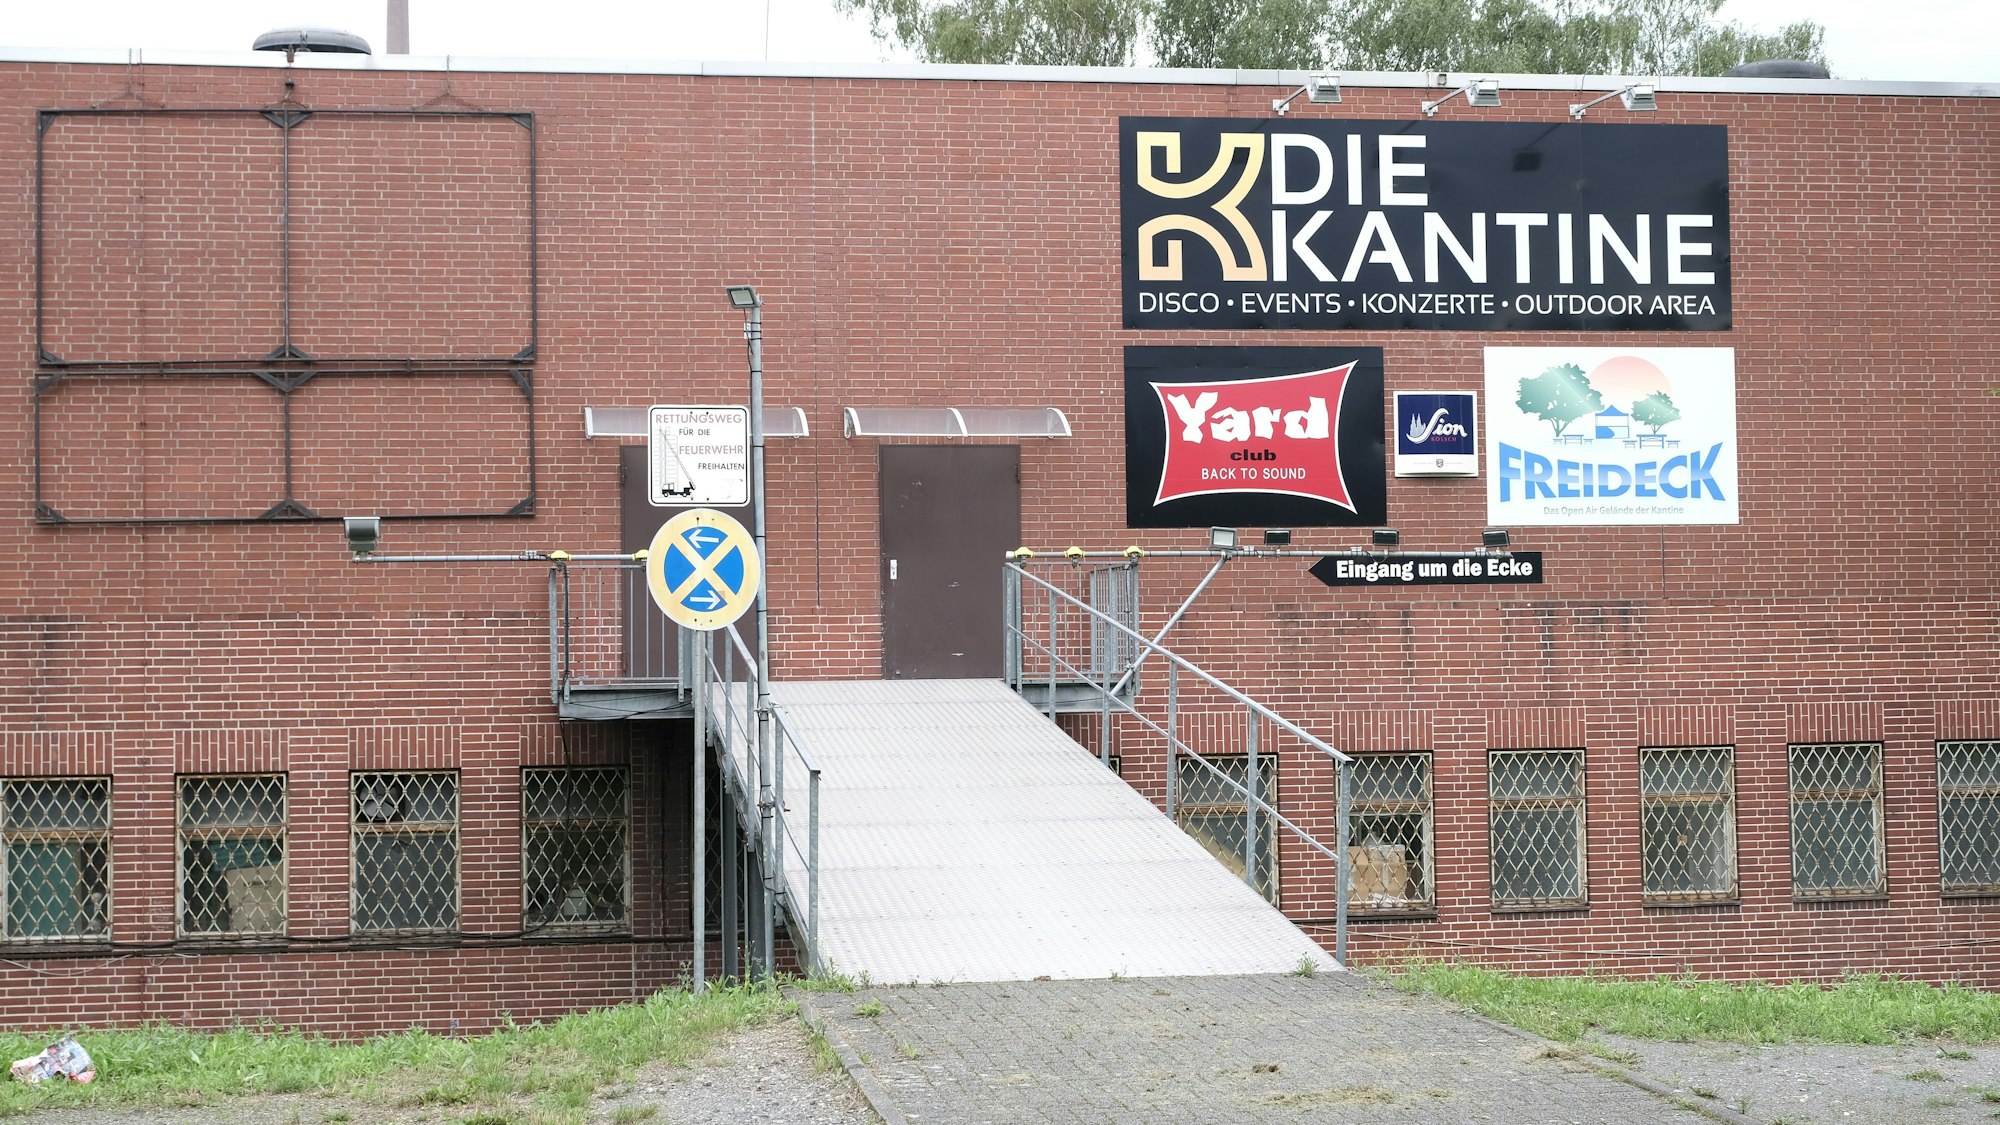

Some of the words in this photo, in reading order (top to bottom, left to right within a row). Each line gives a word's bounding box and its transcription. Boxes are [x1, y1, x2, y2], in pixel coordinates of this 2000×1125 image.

[1271, 133, 1428, 206] DIE
[1271, 210, 1715, 285] KANTINE
[1139, 292, 1220, 313] DISCO
[1242, 293, 1341, 314] EVENTS
[1362, 293, 1495, 314] KONZERTE
[1515, 294, 1643, 315] OUTDOOR
[1649, 295, 1716, 315] AREA
[655, 414, 742, 423] RETTUNGSWEG
[1167, 391, 1329, 444] Yard
[1406, 407, 1468, 444] Sion
[678, 427, 694, 436] FÜR
[698, 428, 711, 436] DIE
[679, 445, 744, 455] FEUERWEHR
[1230, 449, 1277, 461] club
[698, 462, 745, 470] FREIHALTEN
[1201, 467, 1237, 480] BACK
[1240, 467, 1258, 480] TO
[1262, 467, 1306, 480] SOUND
[1499, 441, 1726, 503] FREIDECK
[1543, 506, 1559, 515] Das
[1561, 506, 1584, 517] Open
[1585, 506, 1598, 515] Air
[1599, 505, 1634, 515] Gelände
[1635, 505, 1650, 515] der
[1651, 505, 1684, 515] Kantine
[1336, 560, 1414, 582] Eingang
[1418, 562, 1447, 577] um
[1452, 559, 1482, 577] die
[1487, 559, 1533, 577] Ecke
